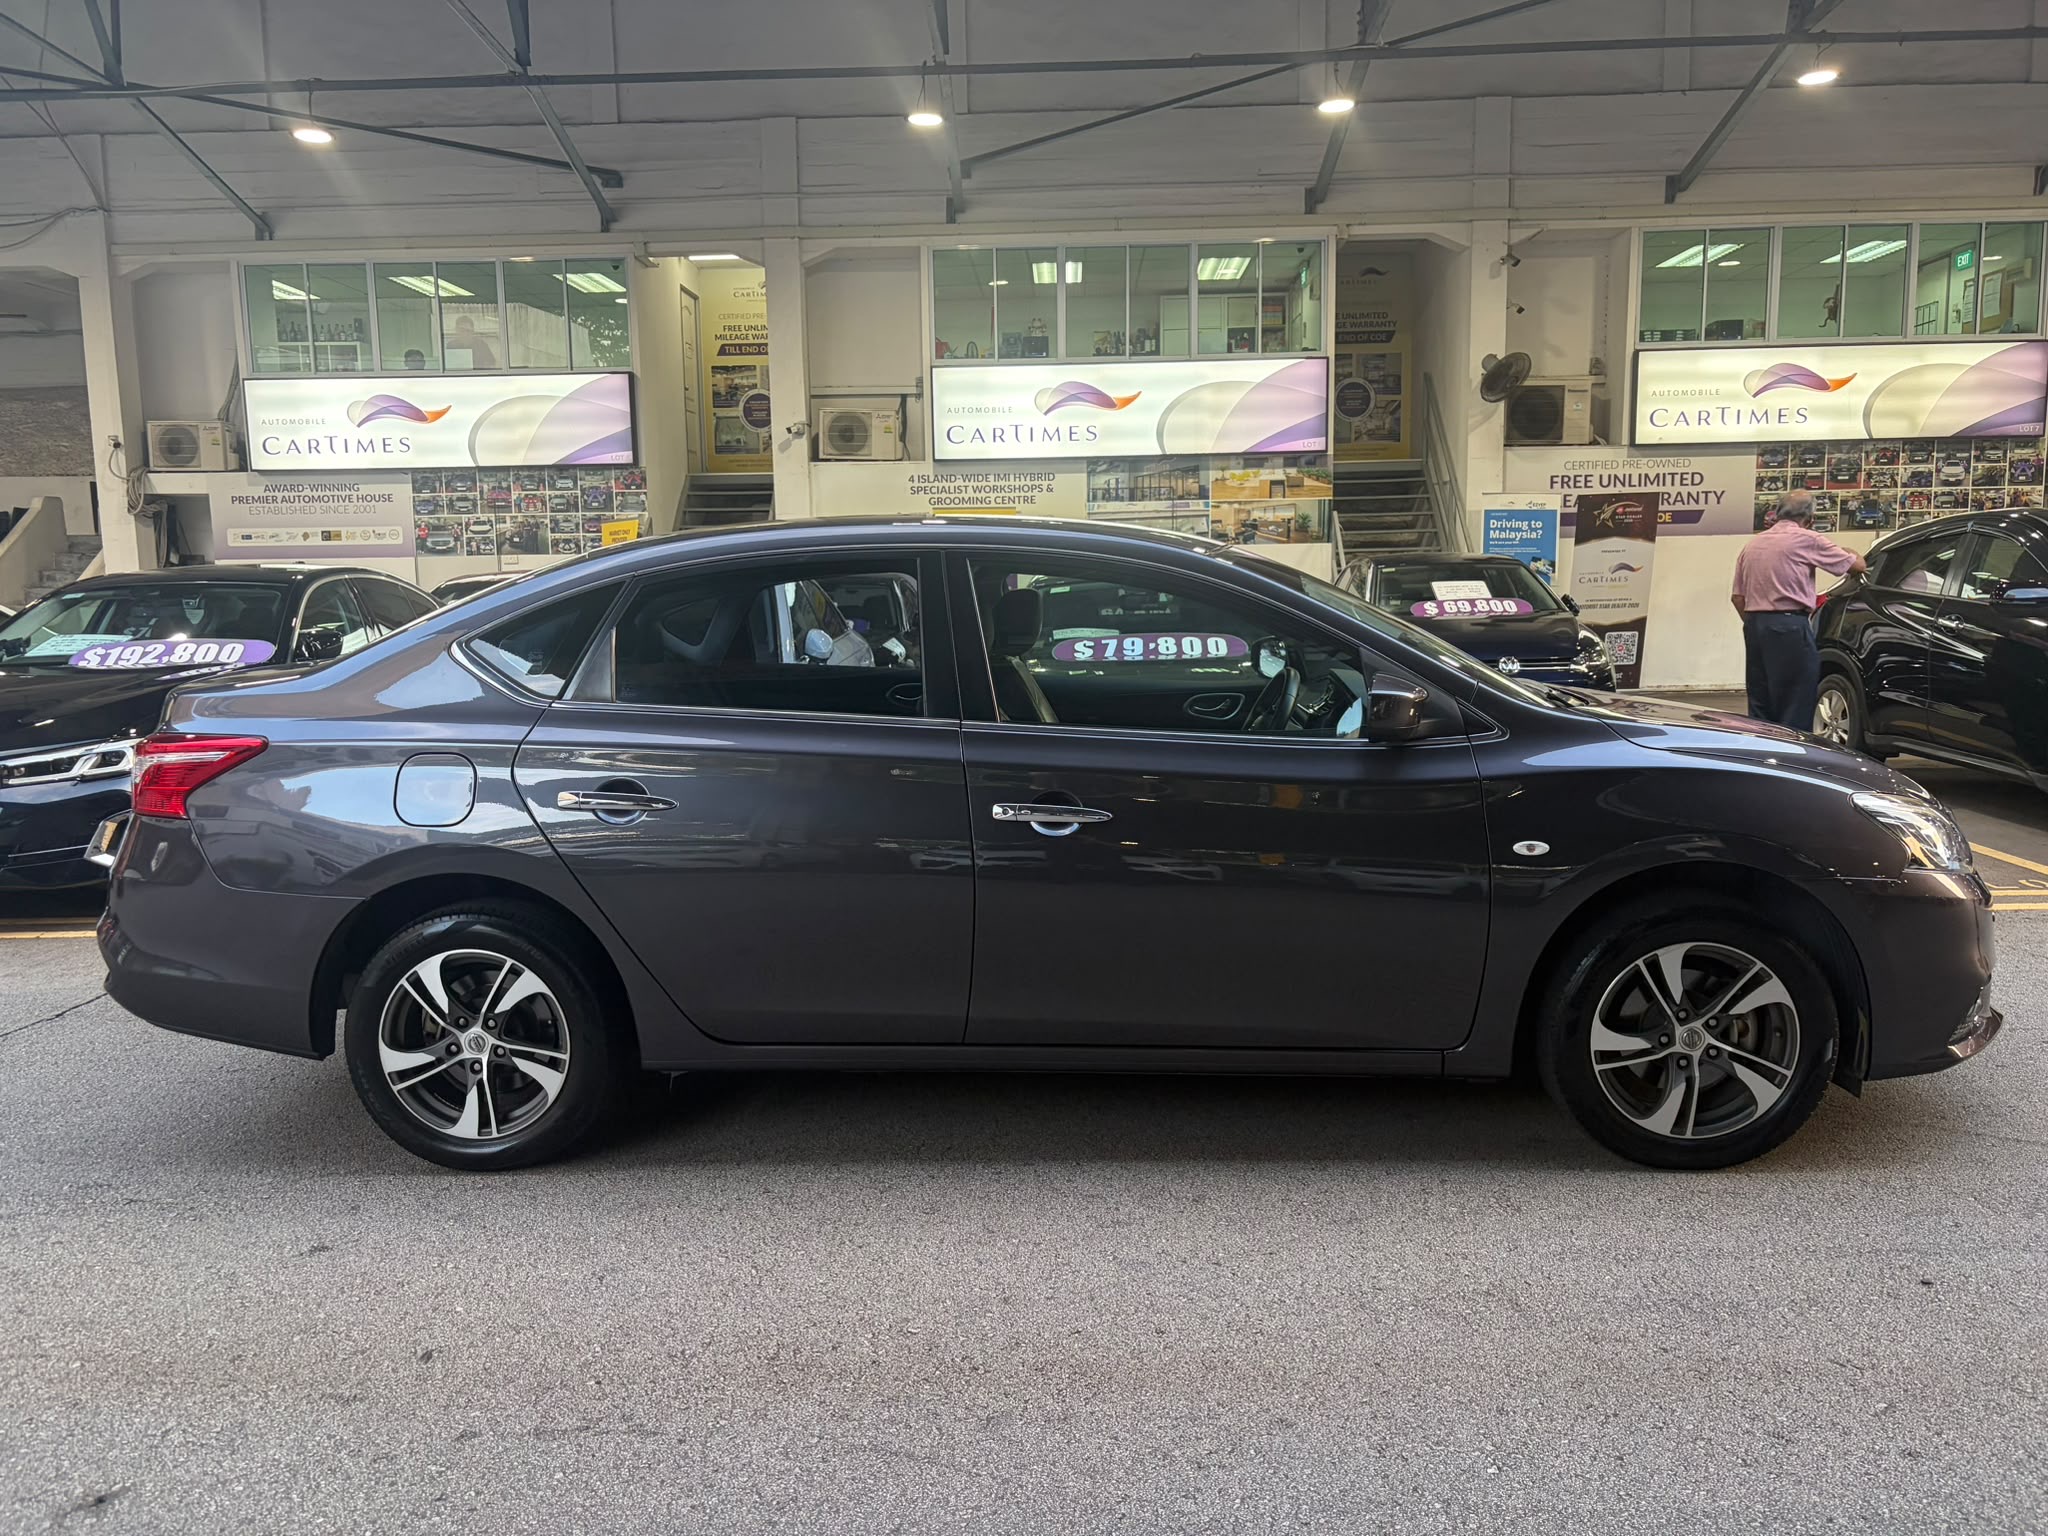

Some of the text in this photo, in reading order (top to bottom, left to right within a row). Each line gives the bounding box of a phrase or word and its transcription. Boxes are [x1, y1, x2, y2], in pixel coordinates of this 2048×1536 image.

[1957, 253, 1970, 267] EXIT
[1342, 312, 1389, 320] UNLIMITED
[1349, 321, 1398, 329] WARRANTY
[714, 333, 750, 341] MILEAGE
[724, 346, 740, 354] TILL
[742, 345, 759, 353] END
[1651, 388, 1721, 397] AUTOMOBILE
[946, 406, 1013, 414] AUTOMOBILE
[261, 418, 327, 426] AUTOMOBILE
[1649, 406, 1808, 428] CARTIMES
[946, 424, 1098, 444] CARTIMES
[261, 435, 411, 456] CARTIMES
[1564, 458, 1692, 471] CERTIFIED PRE-OWNED
[908, 472, 1056, 483] 4 ISLAND-WIDE IMI HYBRID
[1549, 472, 1704, 490] FREE UNLIMITED
[263, 483, 360, 494] AWARD-WINNING
[910, 483, 1054, 495] SPECIALIST WORKSHOPS &
[231, 493, 393, 505] PREMIER AUTOMOTIVE HOUSE
[928, 495, 1037, 506] GROOMING CENTRE
[1660, 490, 1726, 506] RANTY
[249, 505, 377, 516] ESTABLISHED SINCE 2001
[1657, 512, 1672, 523] OE
[1489, 519, 1543, 531] Driving to
[1489, 530, 1543, 541] Malaysia?
[78, 643, 245, 667] $192,800
